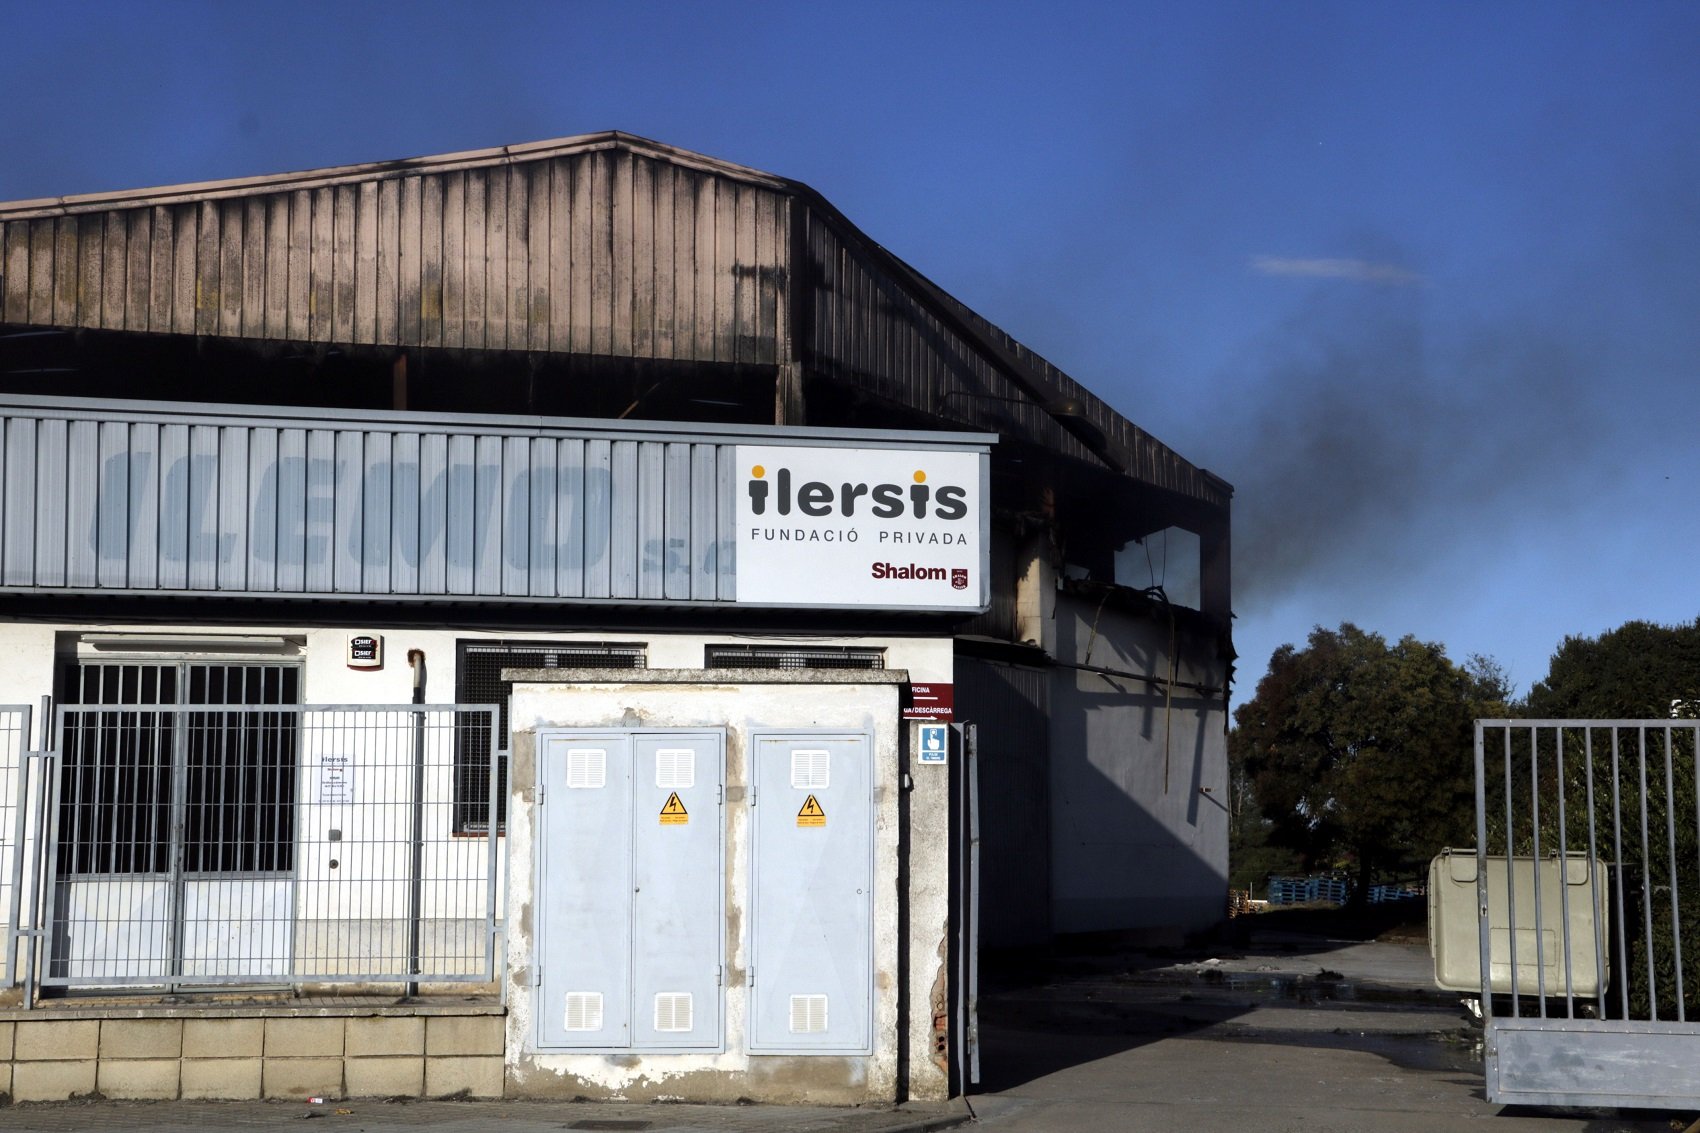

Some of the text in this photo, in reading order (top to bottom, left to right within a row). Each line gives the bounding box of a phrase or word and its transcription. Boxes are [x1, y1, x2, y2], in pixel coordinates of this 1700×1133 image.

[748, 464, 968, 521] ilersis
[751, 527, 967, 545] FUNDACIÓ PRIVADA
[871, 562, 947, 581] Shalom
